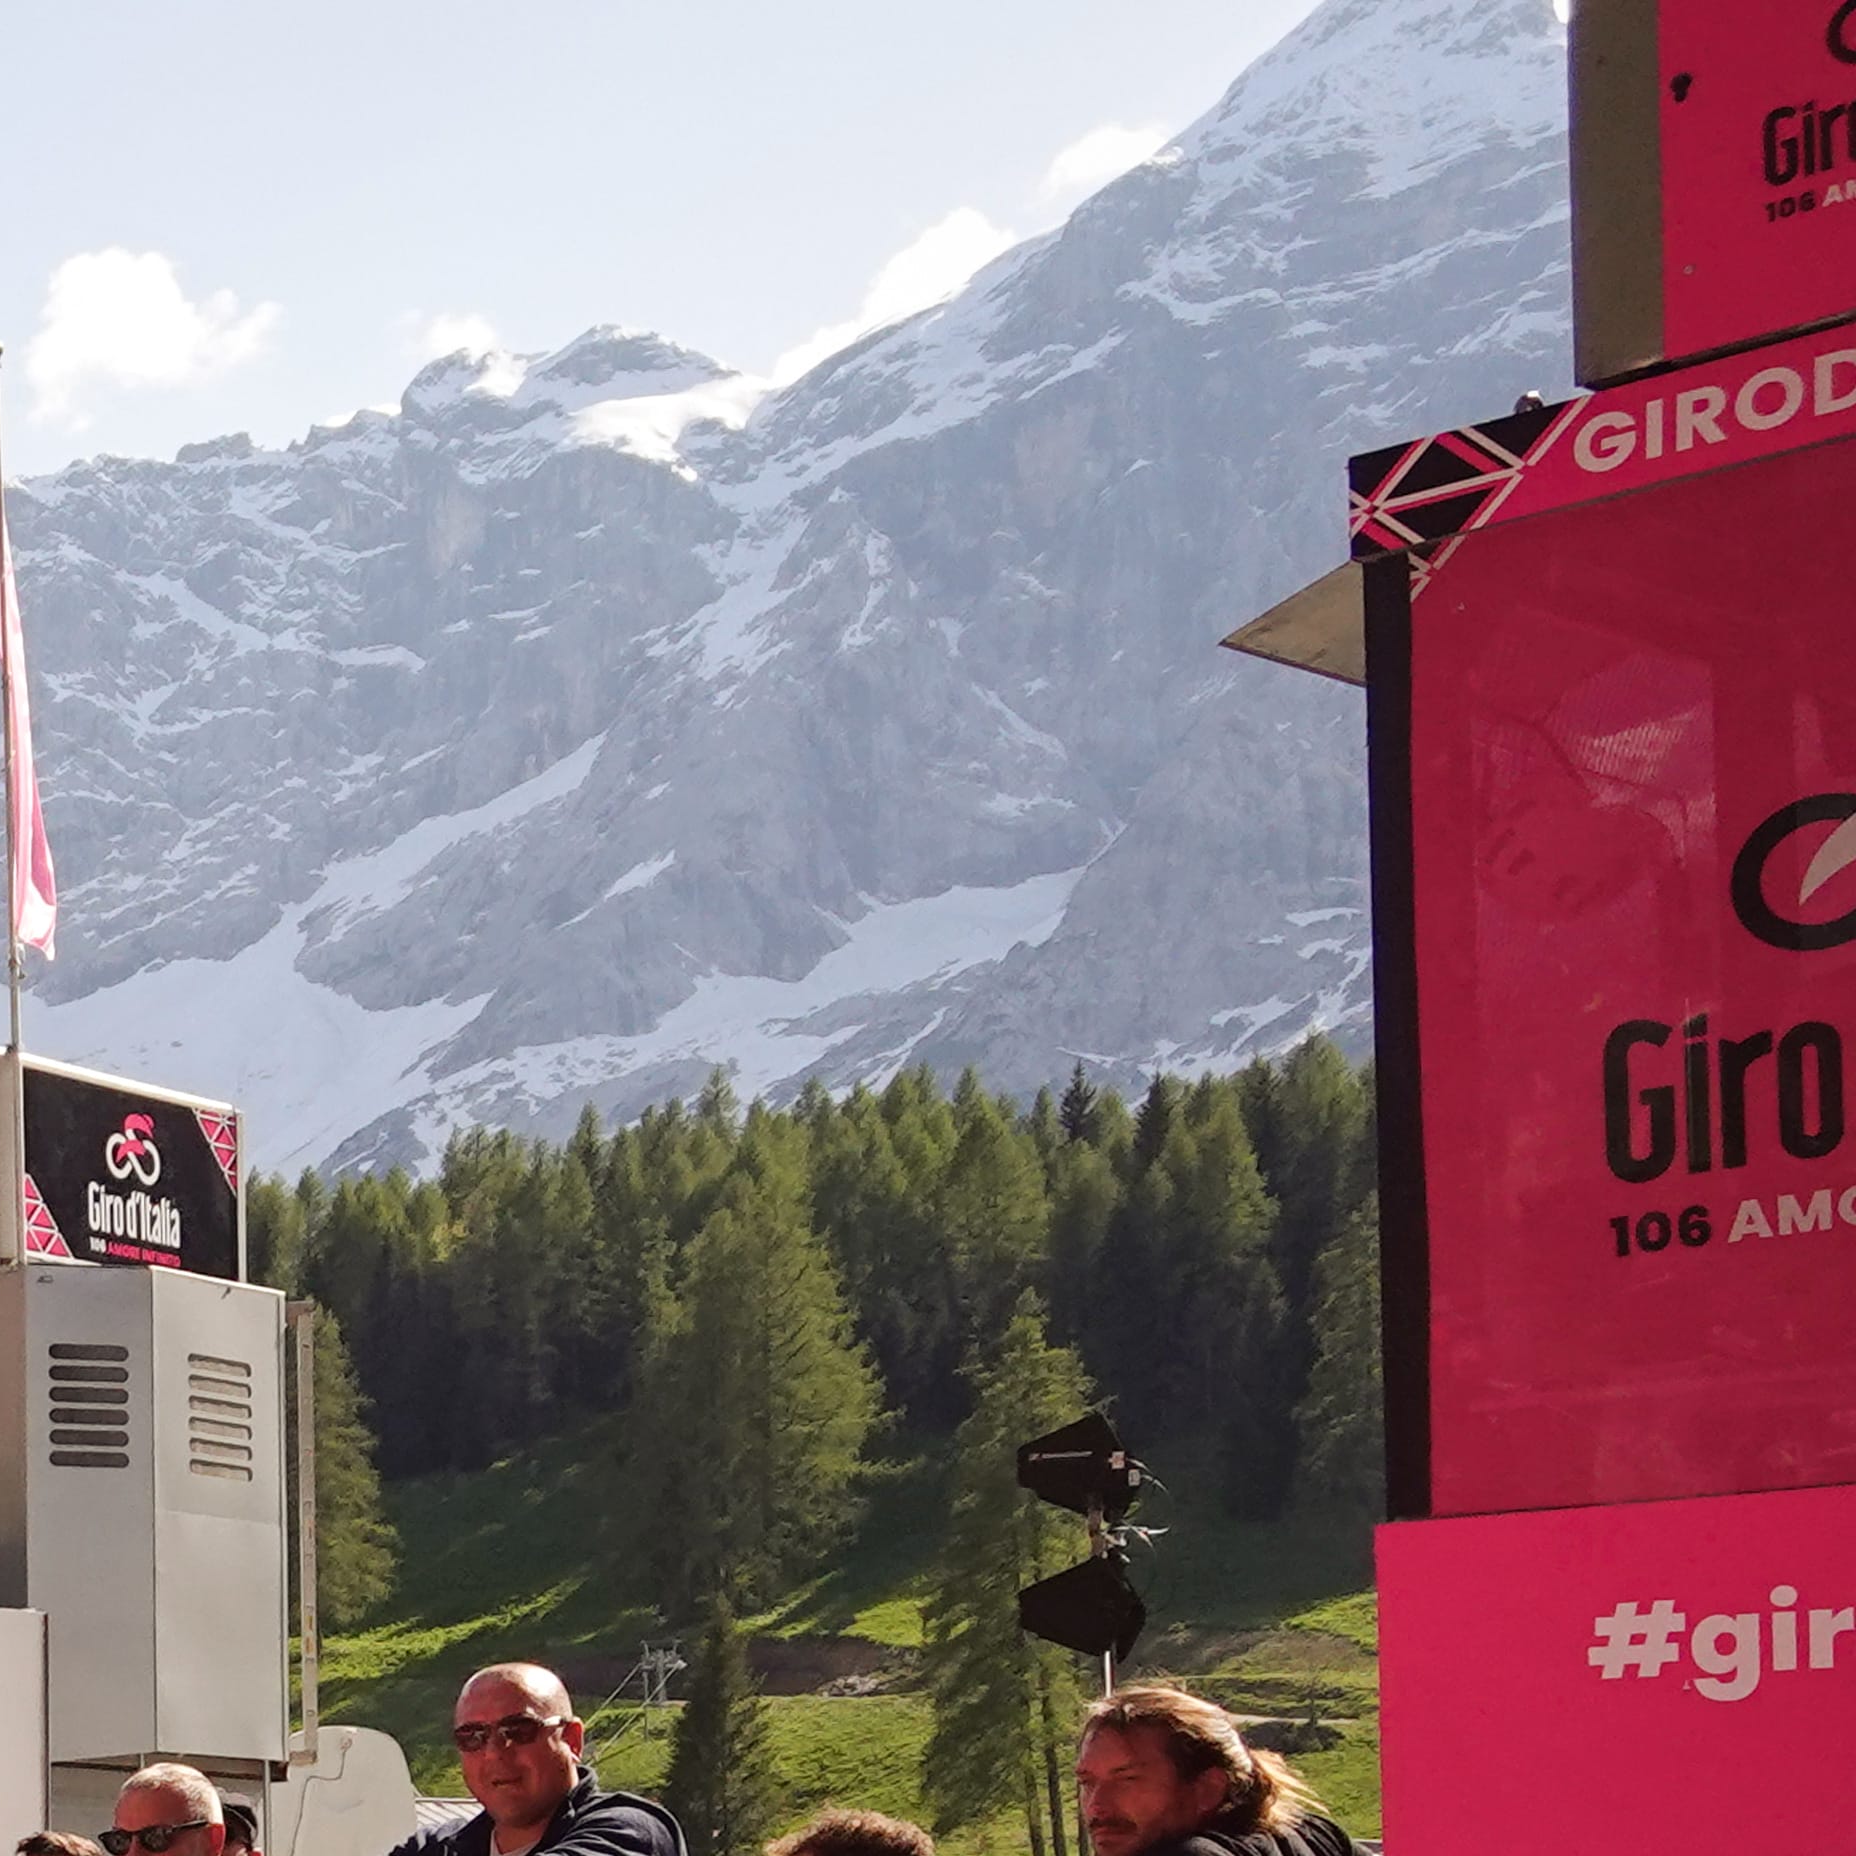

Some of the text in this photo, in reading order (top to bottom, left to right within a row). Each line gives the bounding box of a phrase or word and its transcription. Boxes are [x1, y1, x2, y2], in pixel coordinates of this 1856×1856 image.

[1761, 102, 1856, 186] Gir
[1766, 191, 1816, 222] 106
[1603, 1013, 1845, 1184] Giro
[88, 1181, 181, 1249] Giro d'Italia
[1610, 1205, 1712, 1257] 106
